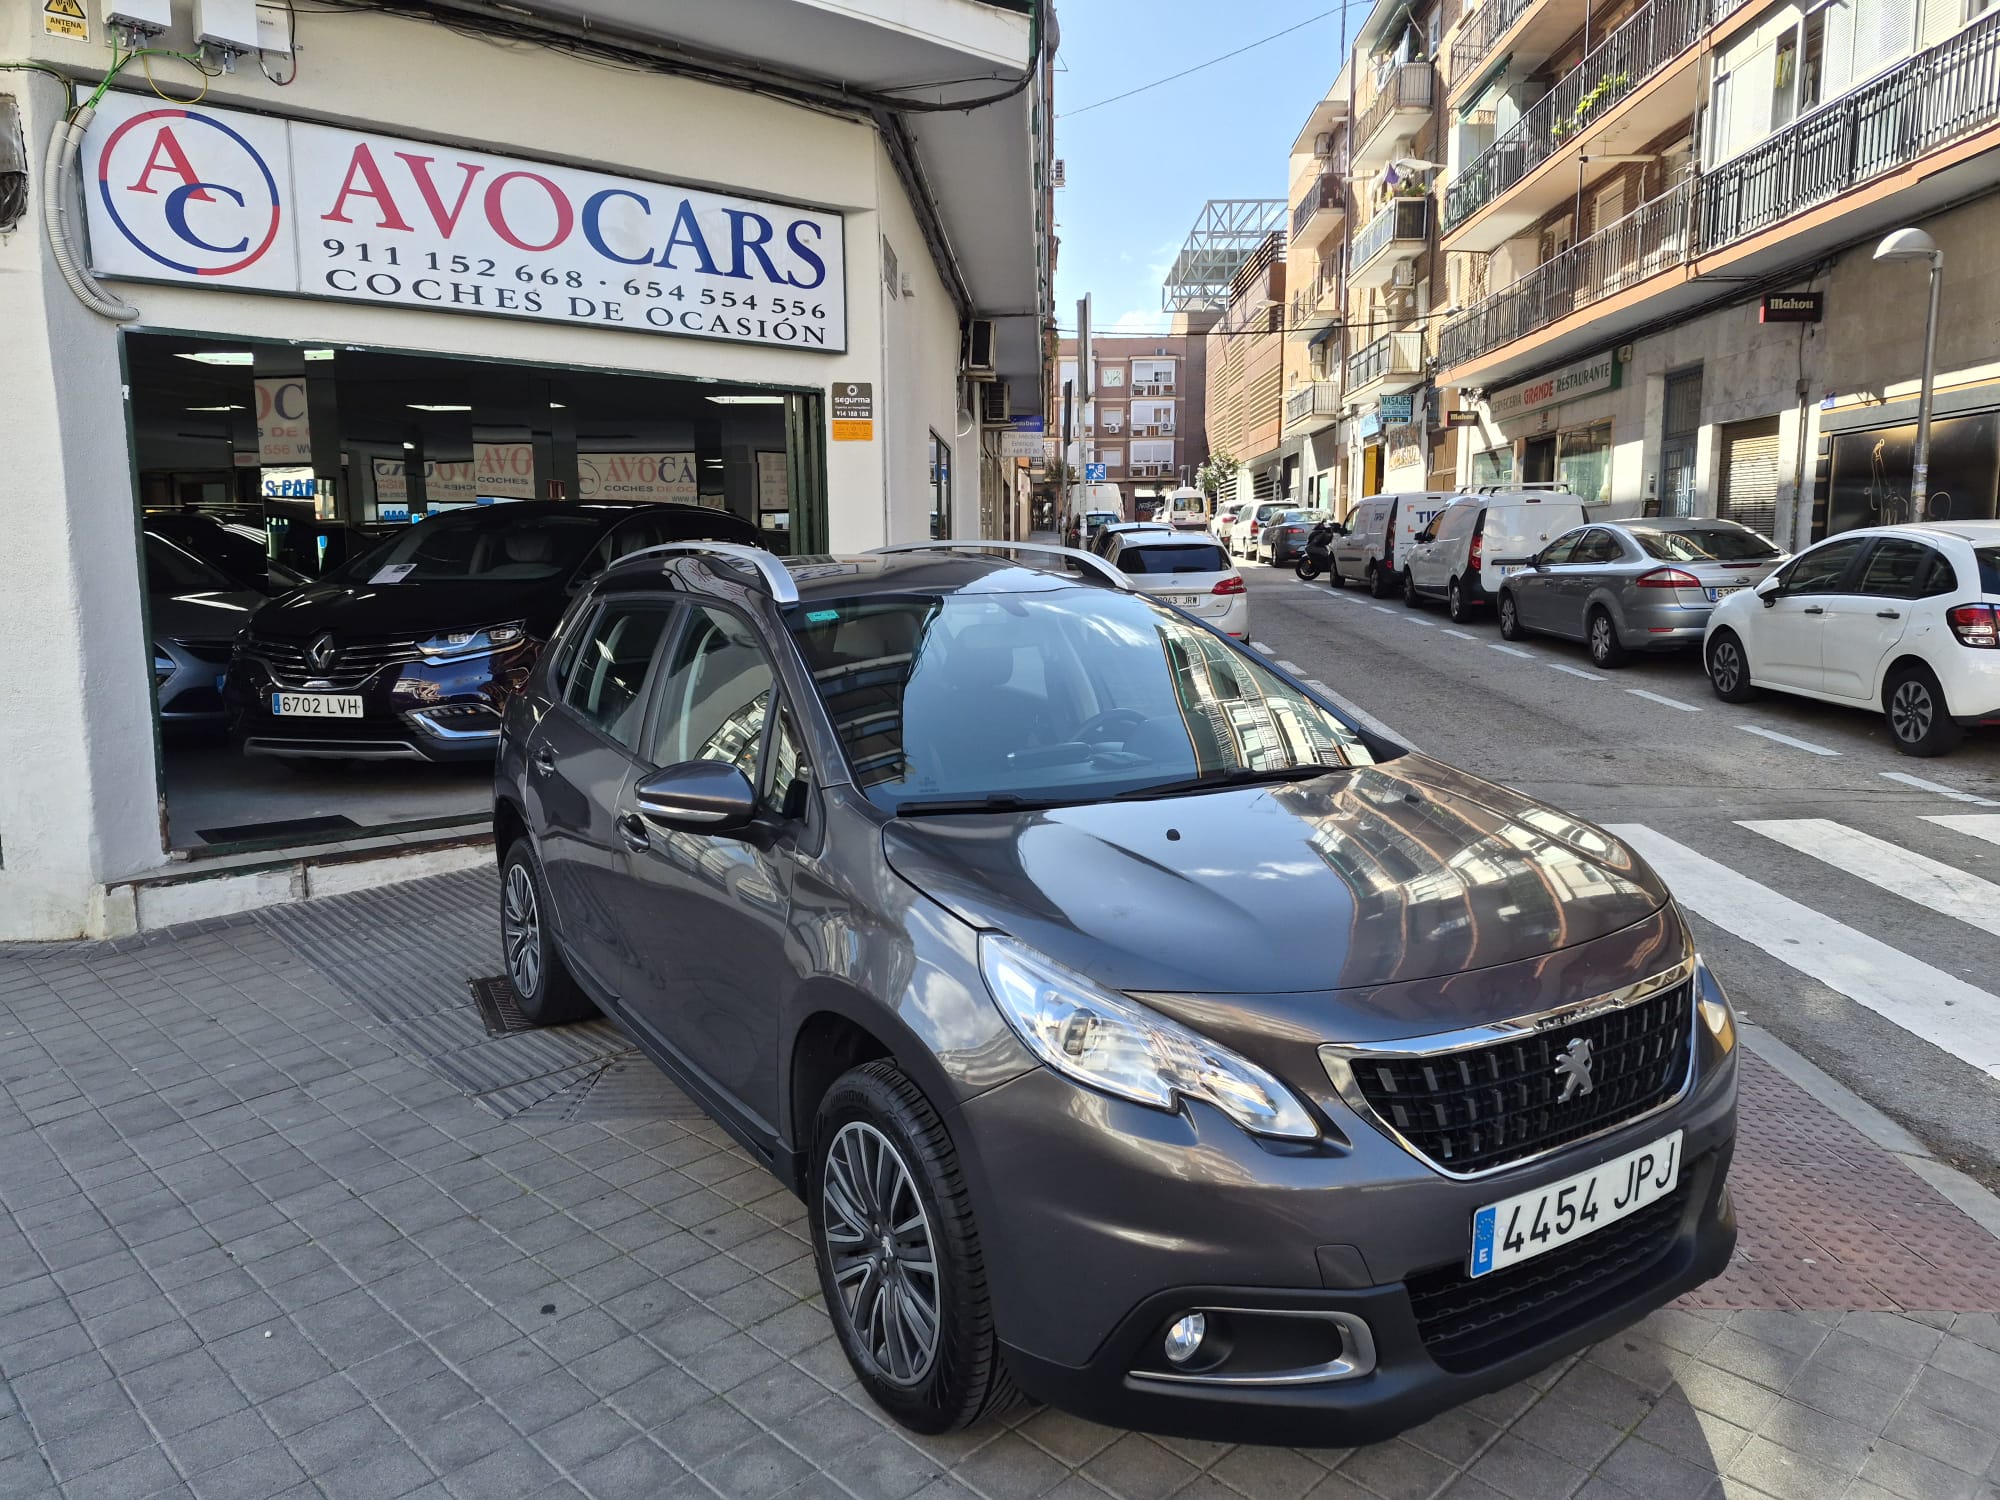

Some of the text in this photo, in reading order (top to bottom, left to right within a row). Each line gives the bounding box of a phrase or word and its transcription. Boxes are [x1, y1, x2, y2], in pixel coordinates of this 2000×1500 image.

[50, 17, 82, 30] ANTENA
[61, 26, 71, 34] RF
[320, 142, 826, 290] AVOCARS
[323, 239, 826, 319] 911 152 668 654 554 556
[325, 269, 826, 345] COCHES DE OCASIÓN
[1770, 298, 1814, 310] Mahou
[1524, 380, 1553, 404] GRANDE
[1557, 362, 1610, 392] RESTAURANTE
[1382, 396, 1411, 405] MASAJES
[477, 477, 529, 485] COCHES
[282, 697, 358, 715] 6702 LVH
[1503, 1142, 1676, 1253] 4454 JPJ
[1479, 1247, 1489, 1264] E
